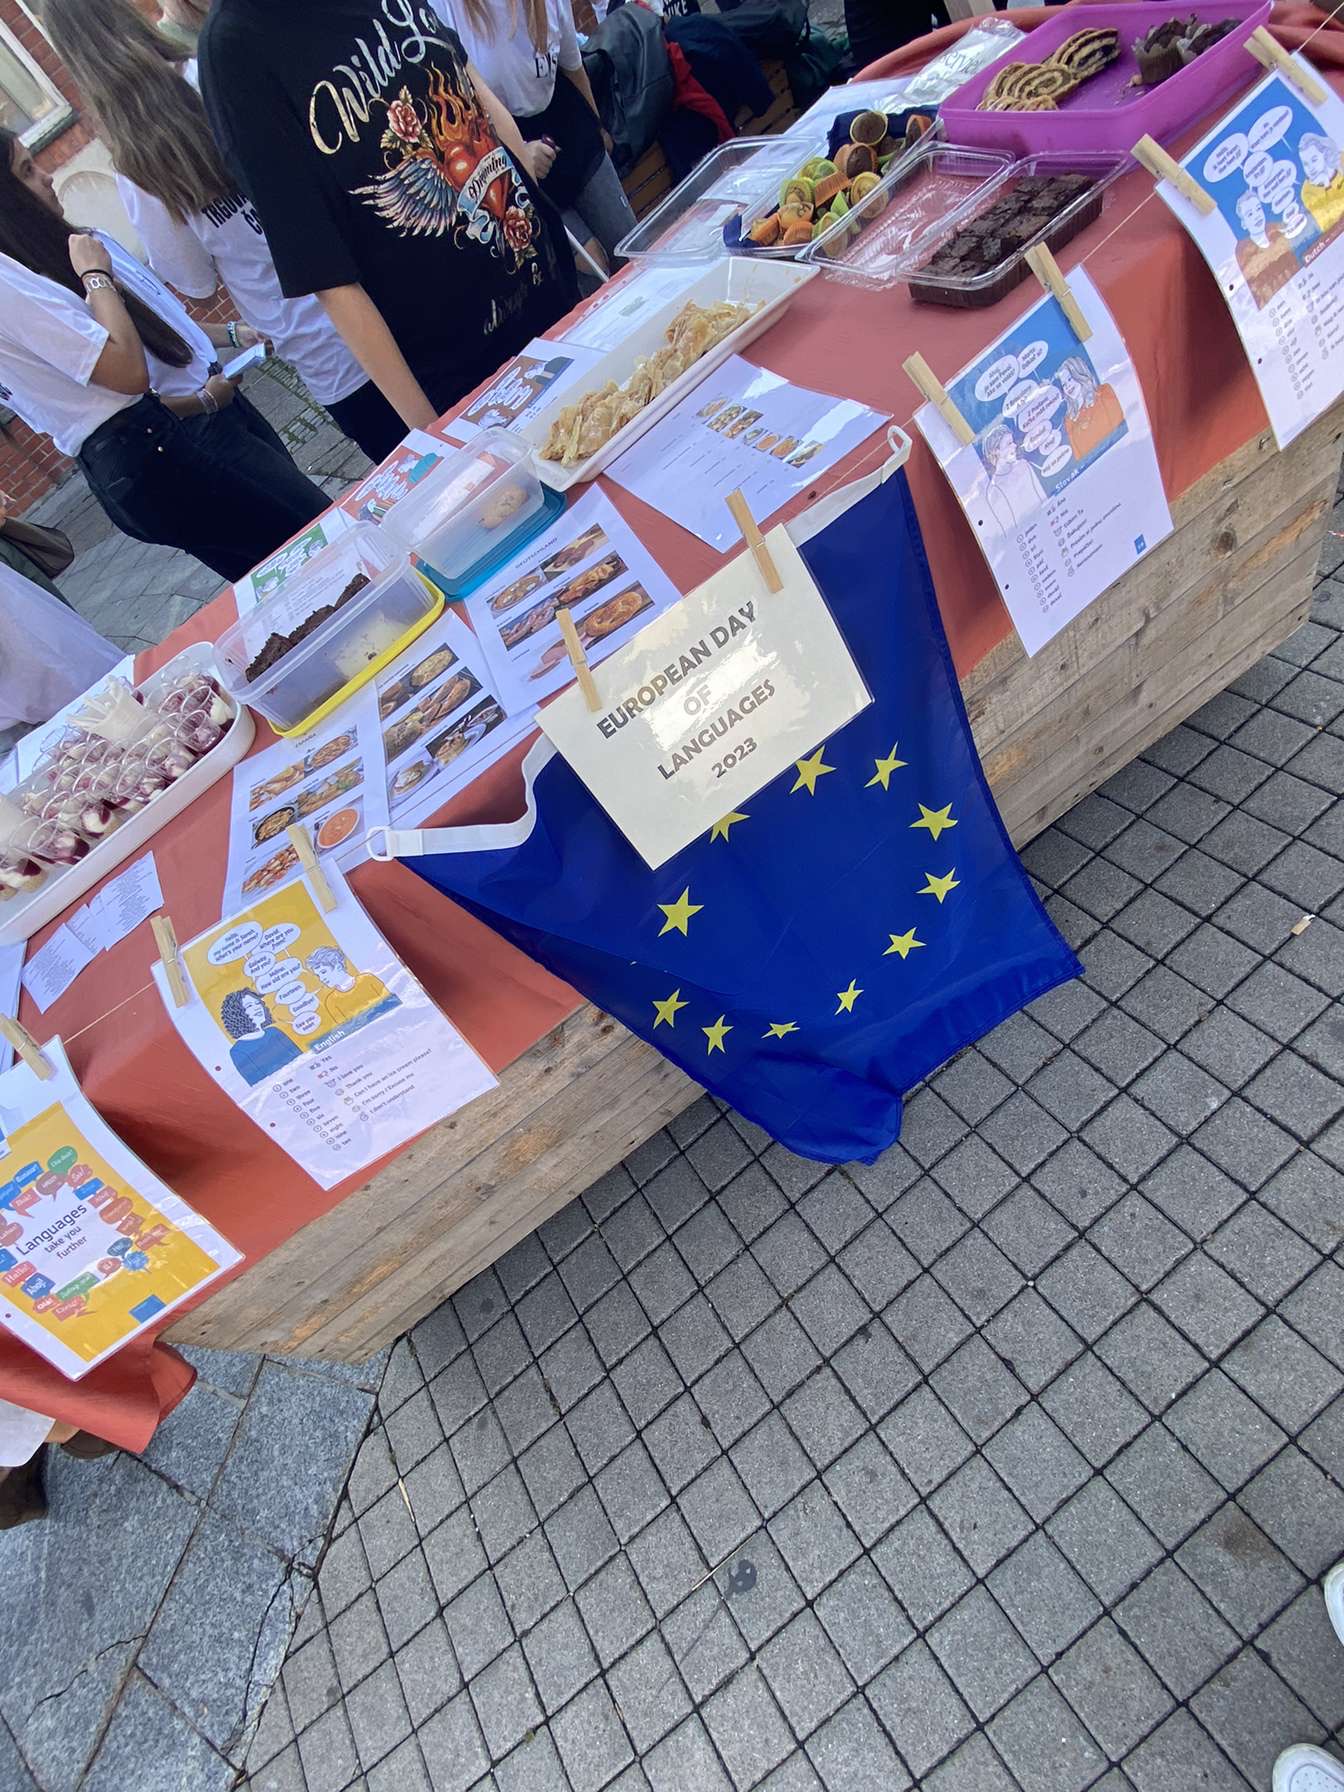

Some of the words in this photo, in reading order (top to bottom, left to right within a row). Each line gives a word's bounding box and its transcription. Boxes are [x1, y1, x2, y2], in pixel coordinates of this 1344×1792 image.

[309, 19, 401, 154] Wild
[1301, 239, 1327, 263] Dutch
[1053, 467, 1082, 492] Slovak
[597, 640, 712, 739] EUROPEAN
[709, 600, 756, 648] DAY
[684, 684, 712, 716] OF
[657, 679, 775, 780] LANGUAGES
[711, 736, 758, 778] 2023
[312, 1028, 347, 1053] English
[14, 1200, 90, 1260] Languages
[43, 1235, 66, 1254] take
[63, 1223, 84, 1243] you
[55, 1233, 89, 1261] further
